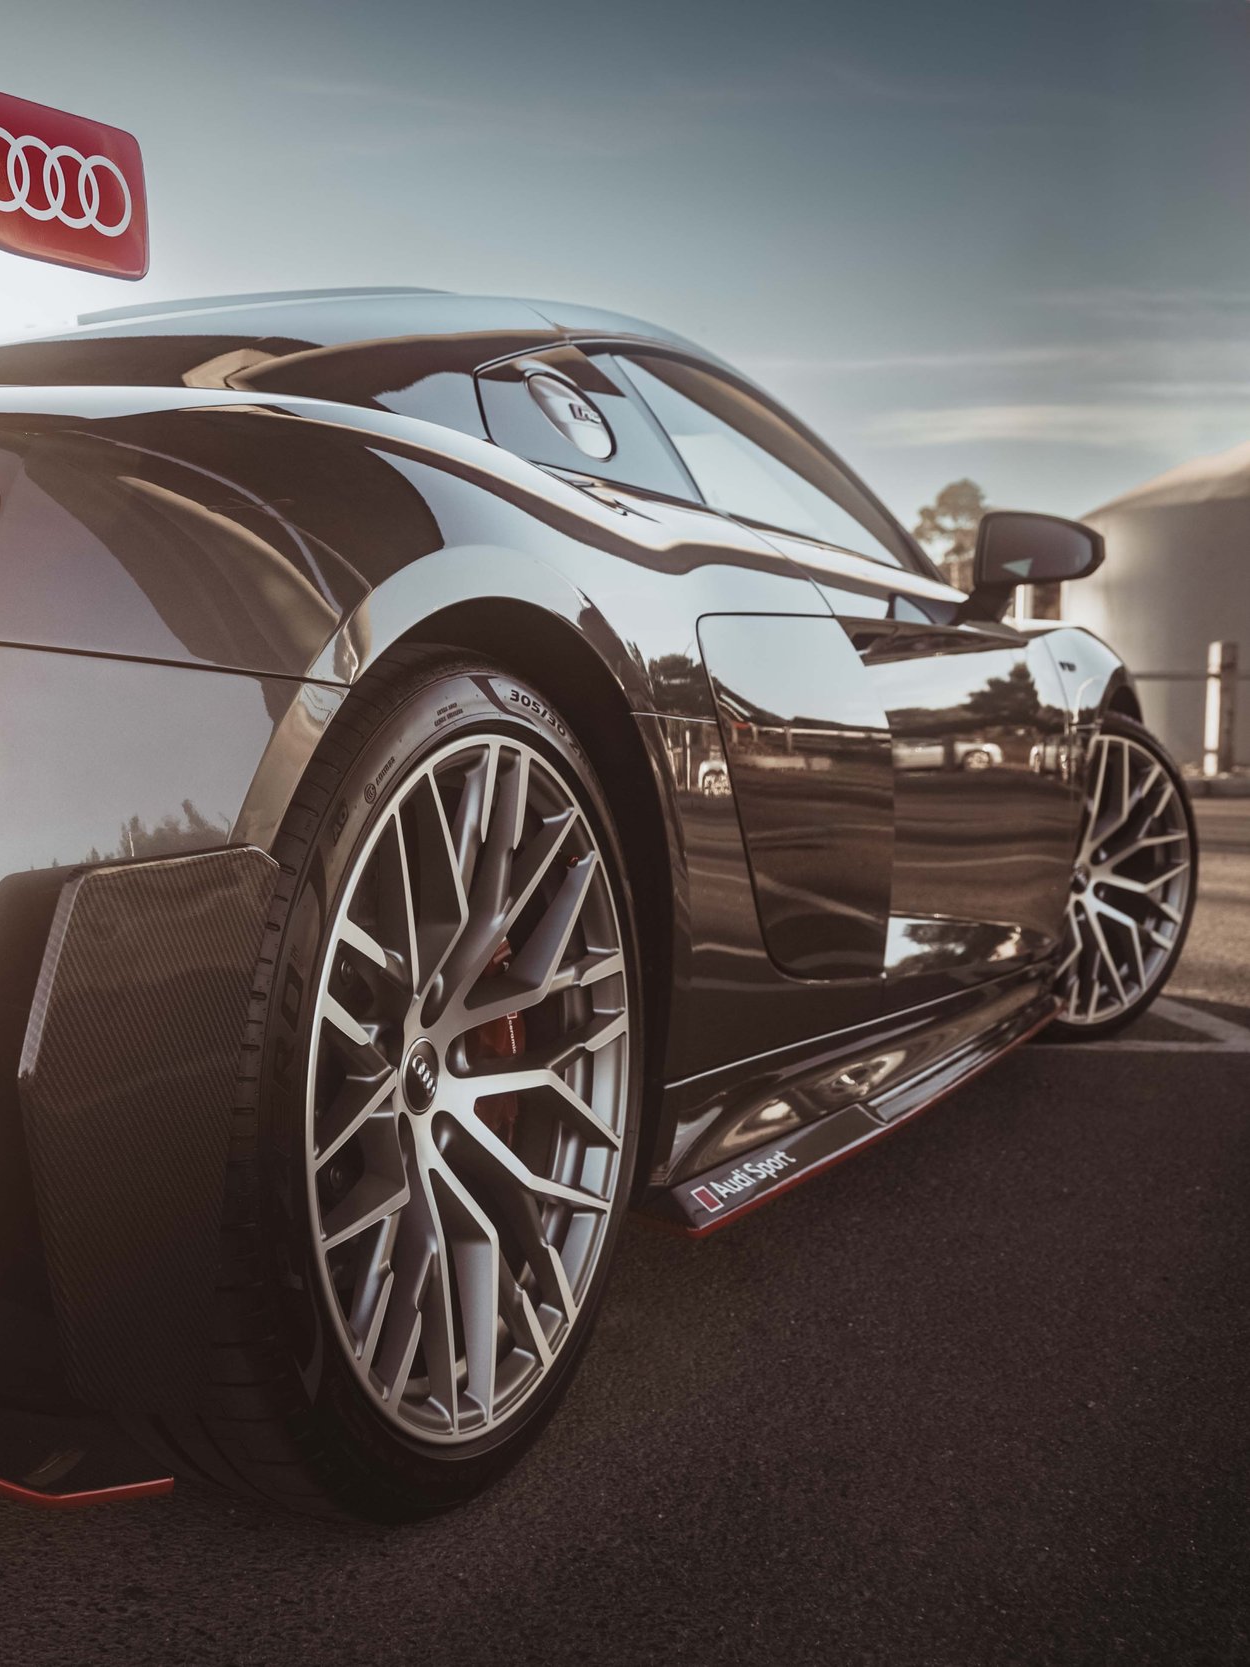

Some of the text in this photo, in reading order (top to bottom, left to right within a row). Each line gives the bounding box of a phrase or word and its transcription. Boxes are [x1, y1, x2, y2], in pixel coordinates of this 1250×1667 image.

[509, 689, 566, 737] 305/30
[508, 1019, 517, 1054] ceramic
[709, 1150, 797, 1198] Audi Sport
